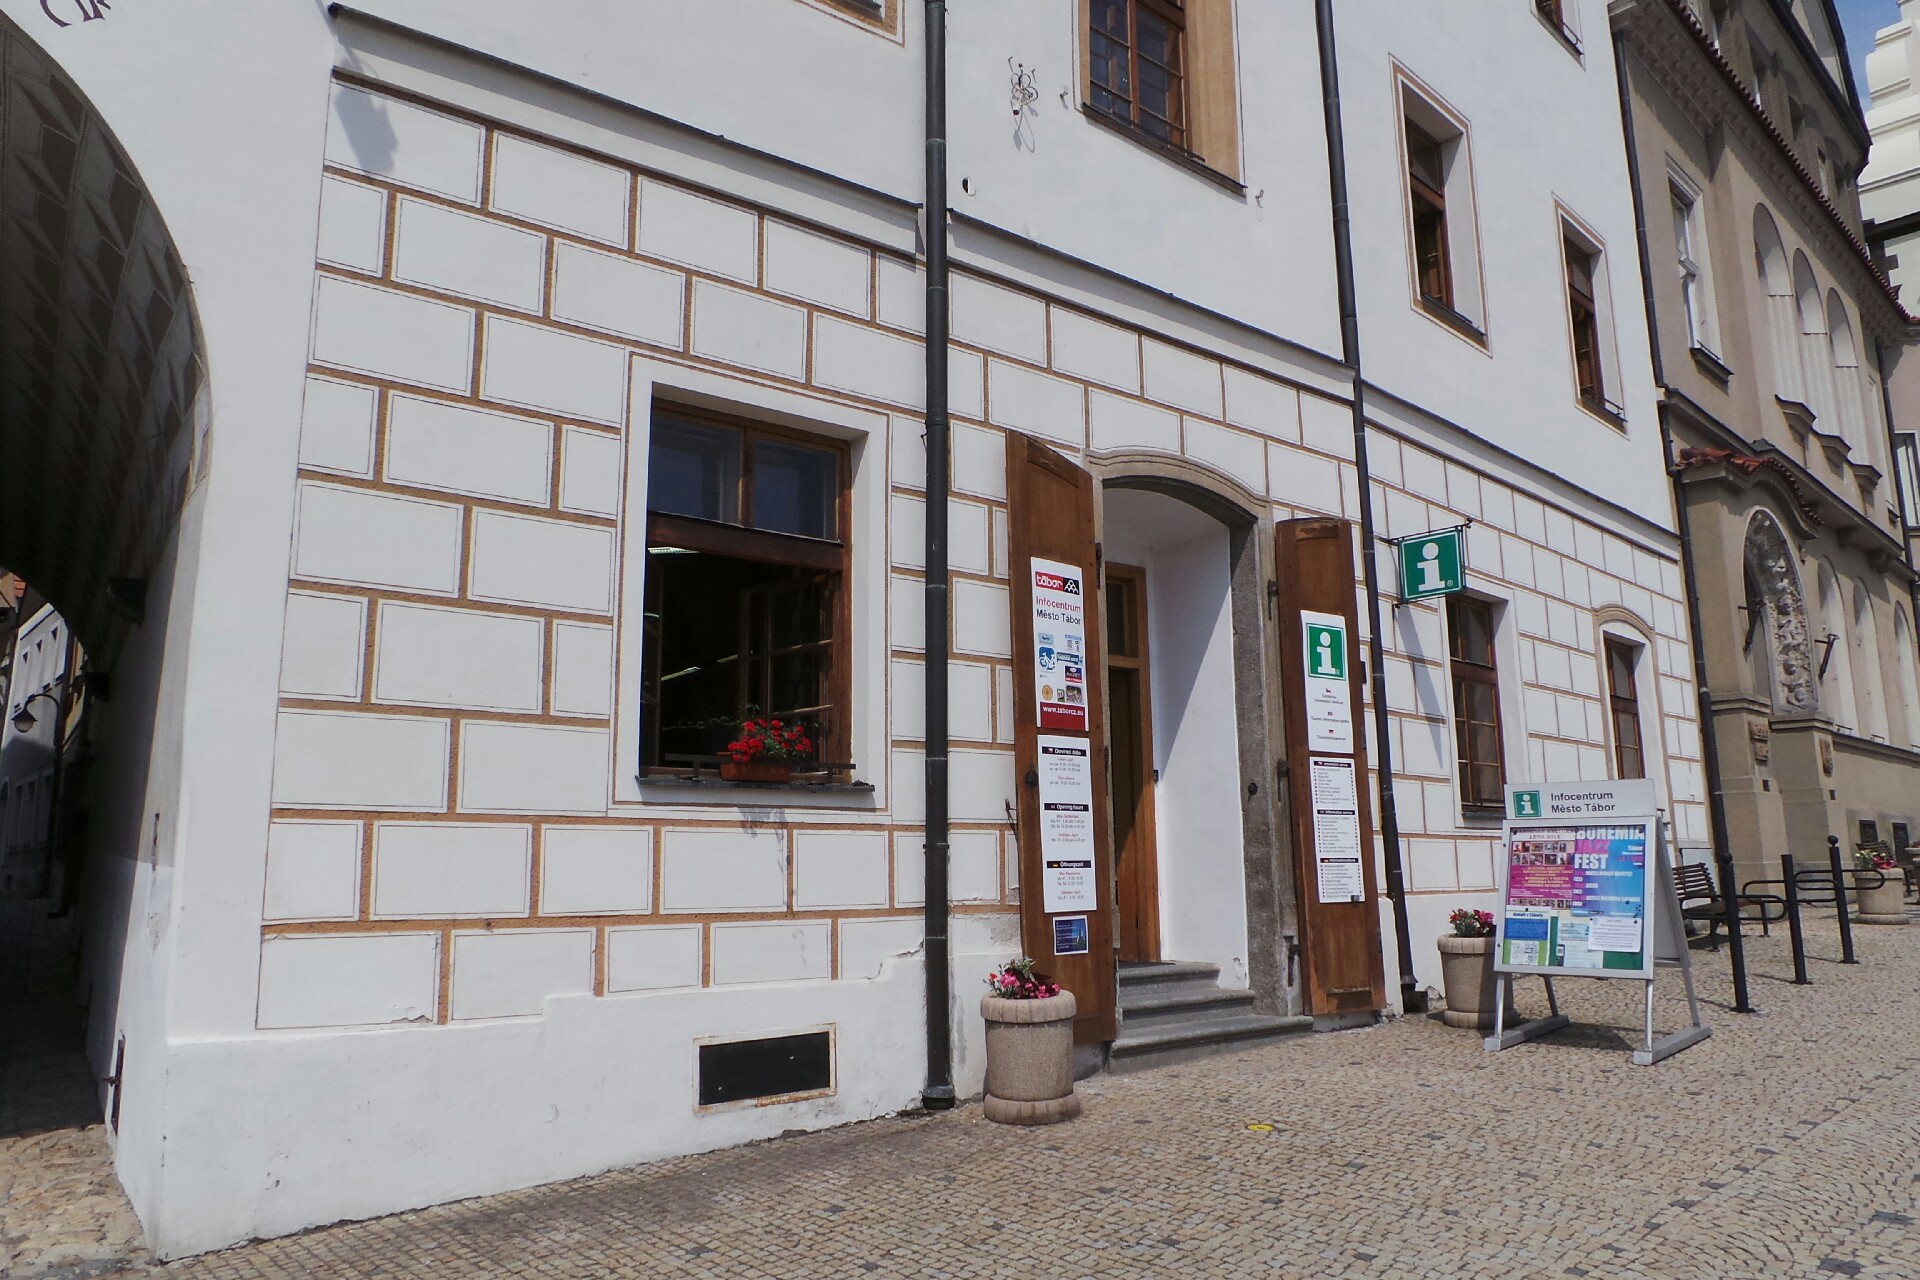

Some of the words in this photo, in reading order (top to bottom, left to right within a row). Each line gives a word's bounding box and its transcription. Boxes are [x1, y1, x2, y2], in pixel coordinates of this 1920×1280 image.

[1036, 596, 1081, 613] Infocentrum
[1036, 608, 1060, 621] Město
[1061, 612, 1081, 625] Tábor
[1042, 706, 1084, 716] www.taborcz.eu
[1550, 791, 1614, 802] Infocentrum
[1056, 803, 1073, 811] Opening
[1551, 803, 1582, 814] Město
[1584, 802, 1616, 813] Tábor
[1575, 825, 1645, 840] BOHEMIA
[1575, 840, 1610, 855] JAZZ
[1574, 853, 1609, 870] FEST
